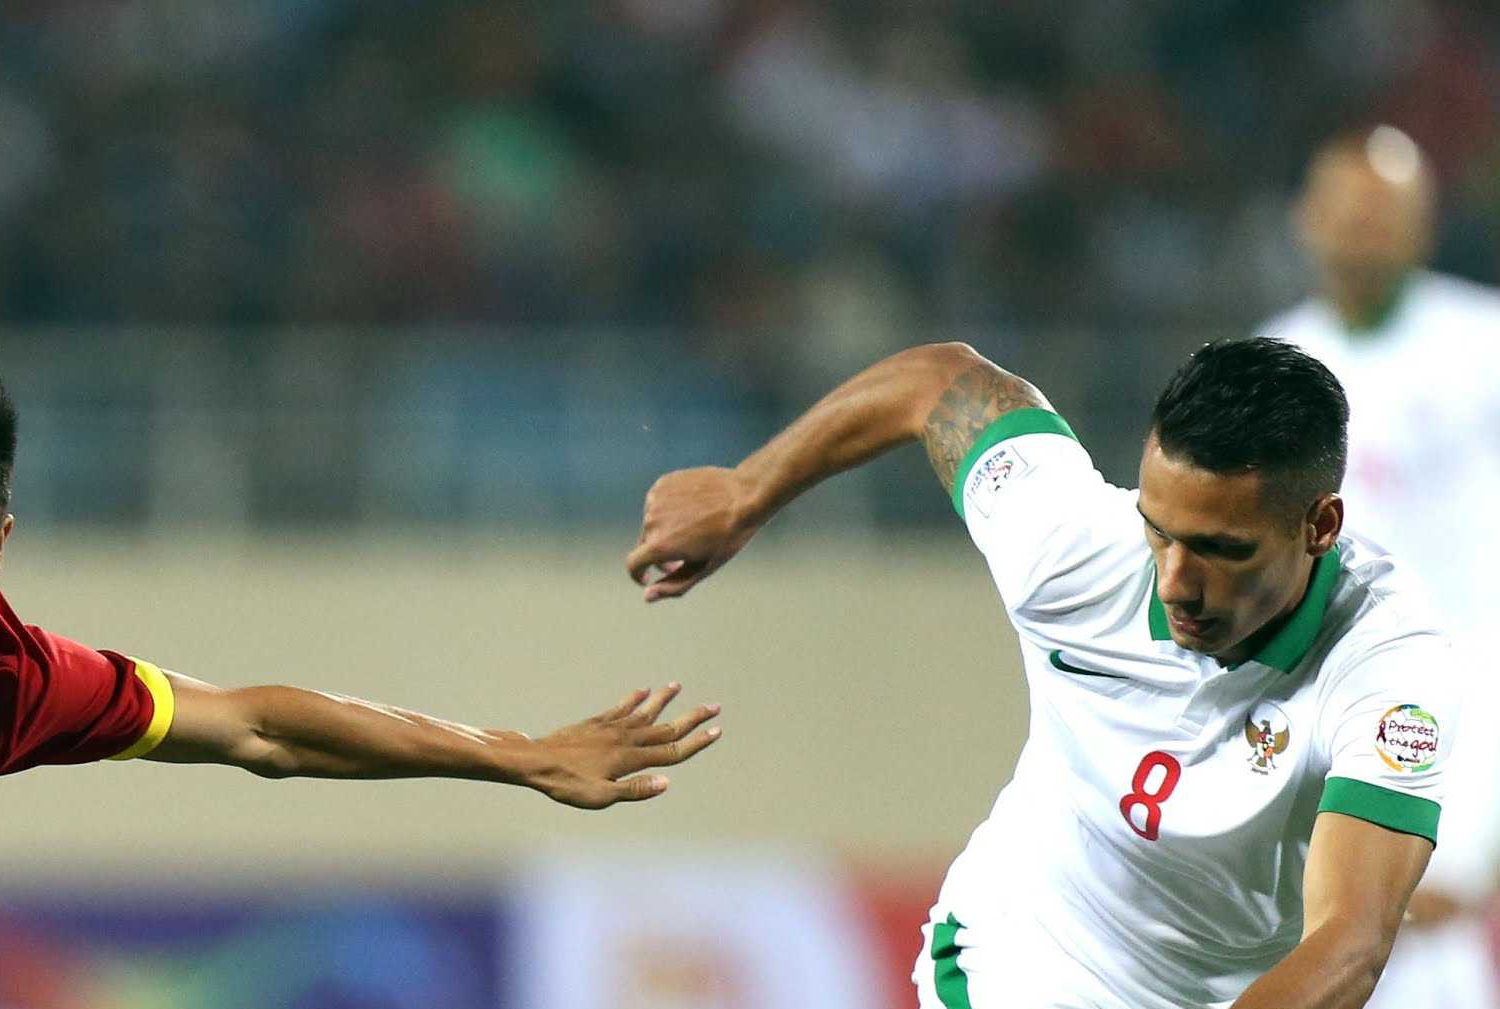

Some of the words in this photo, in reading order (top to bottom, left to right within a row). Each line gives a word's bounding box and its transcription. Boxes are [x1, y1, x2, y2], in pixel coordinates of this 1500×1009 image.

[1388, 720, 1435, 738] Protect
[1389, 737, 1408, 747] the
[1410, 737, 1438, 758] goal
[1119, 750, 1181, 842] 8
